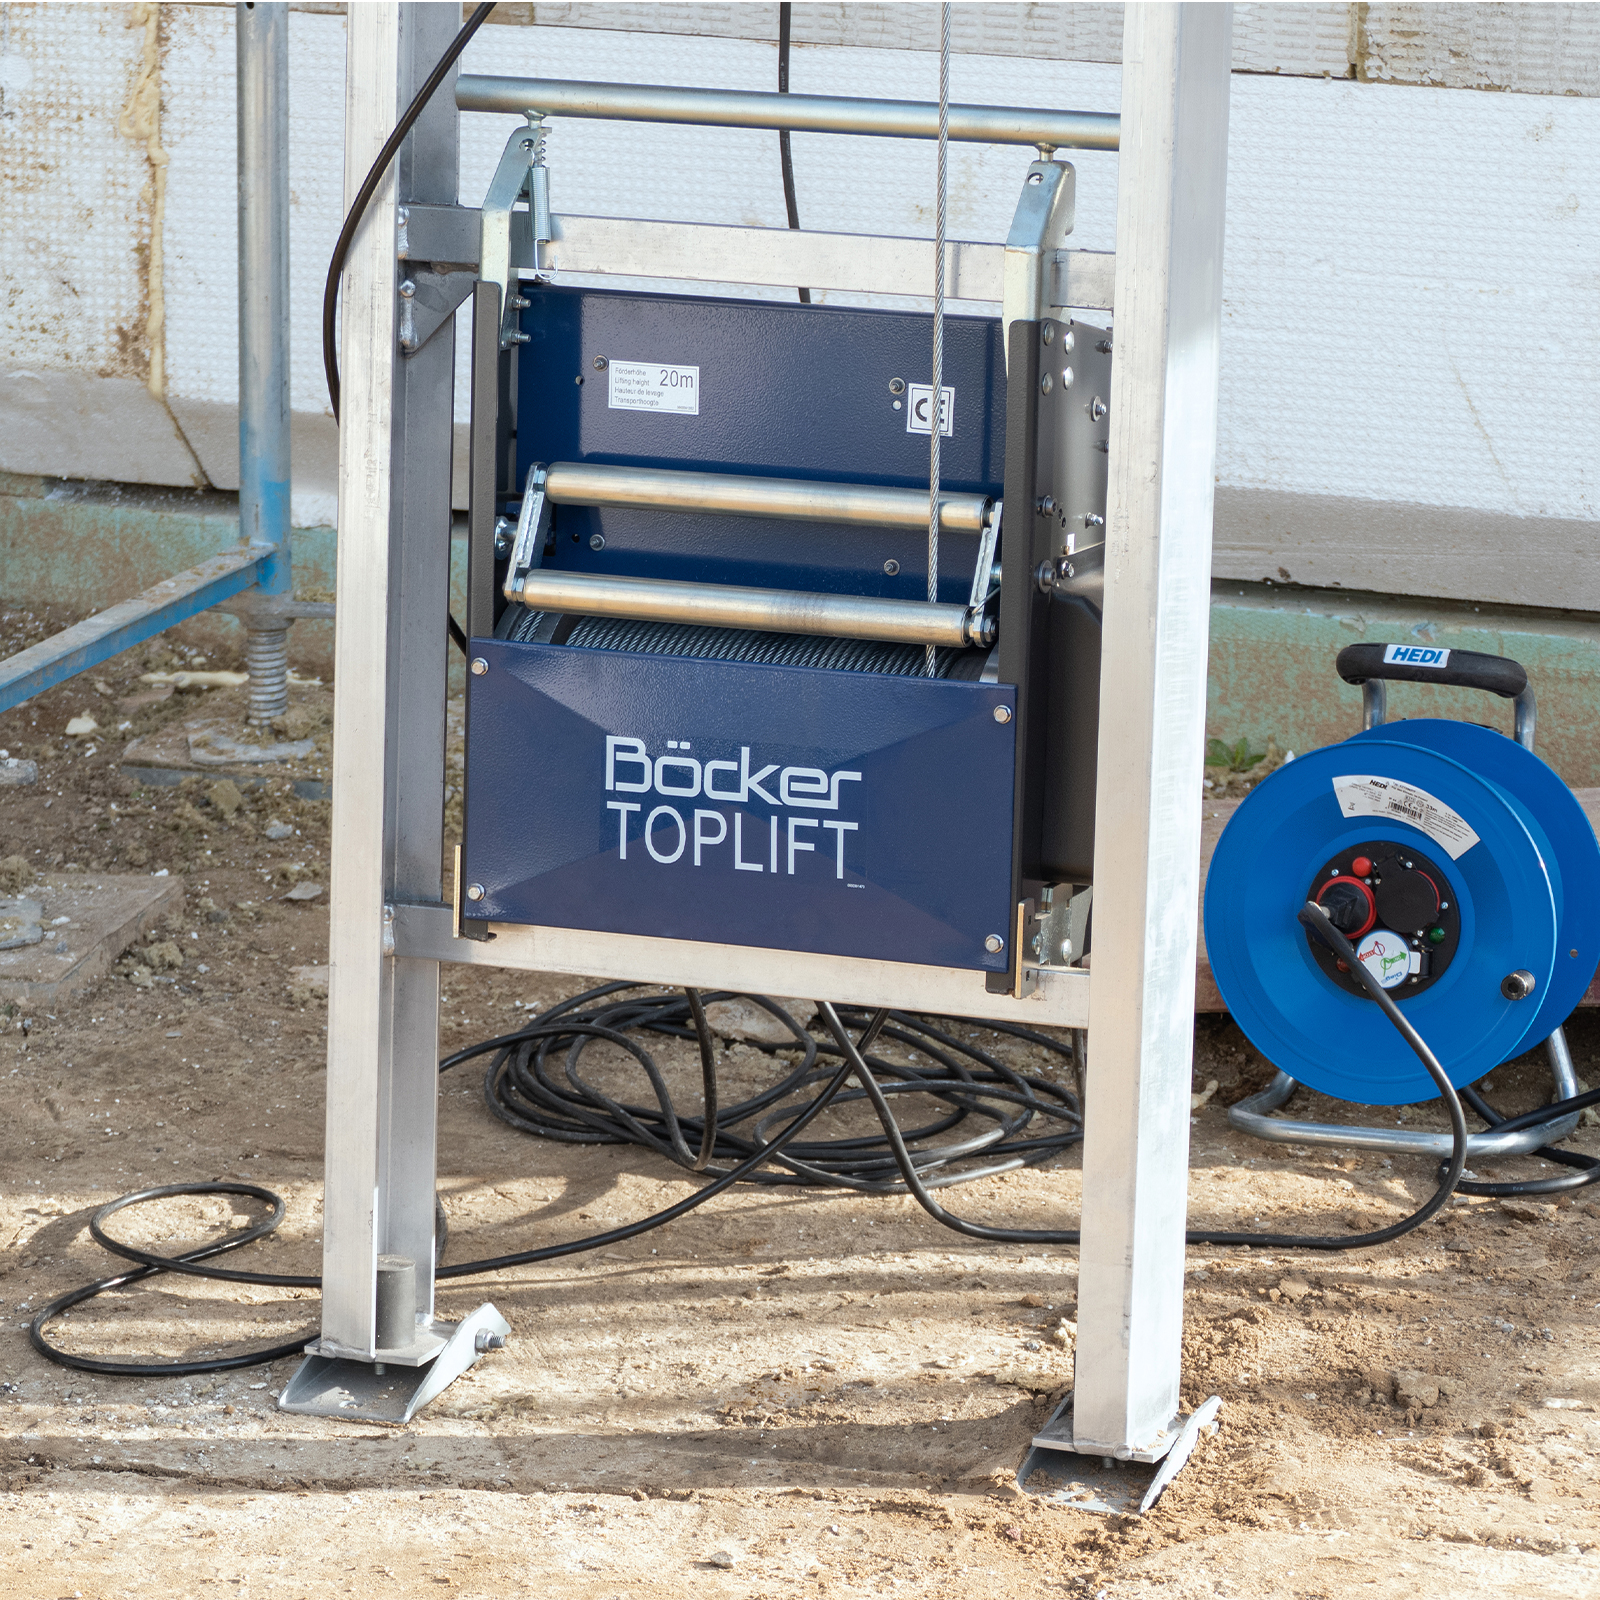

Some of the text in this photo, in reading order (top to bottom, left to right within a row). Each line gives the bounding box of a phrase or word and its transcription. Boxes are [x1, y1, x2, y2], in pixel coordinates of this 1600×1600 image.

[615, 377, 649, 387] Lifting height
[660, 369, 693, 388] 20m
[615, 386, 636, 394] Hauteur
[646, 389, 664, 398] levage
[1391, 647, 1443, 664] HEDI
[605, 734, 862, 810] Böcker
[1369, 779, 1388, 790] HEDI
[606, 800, 859, 879] TOPLIFT
